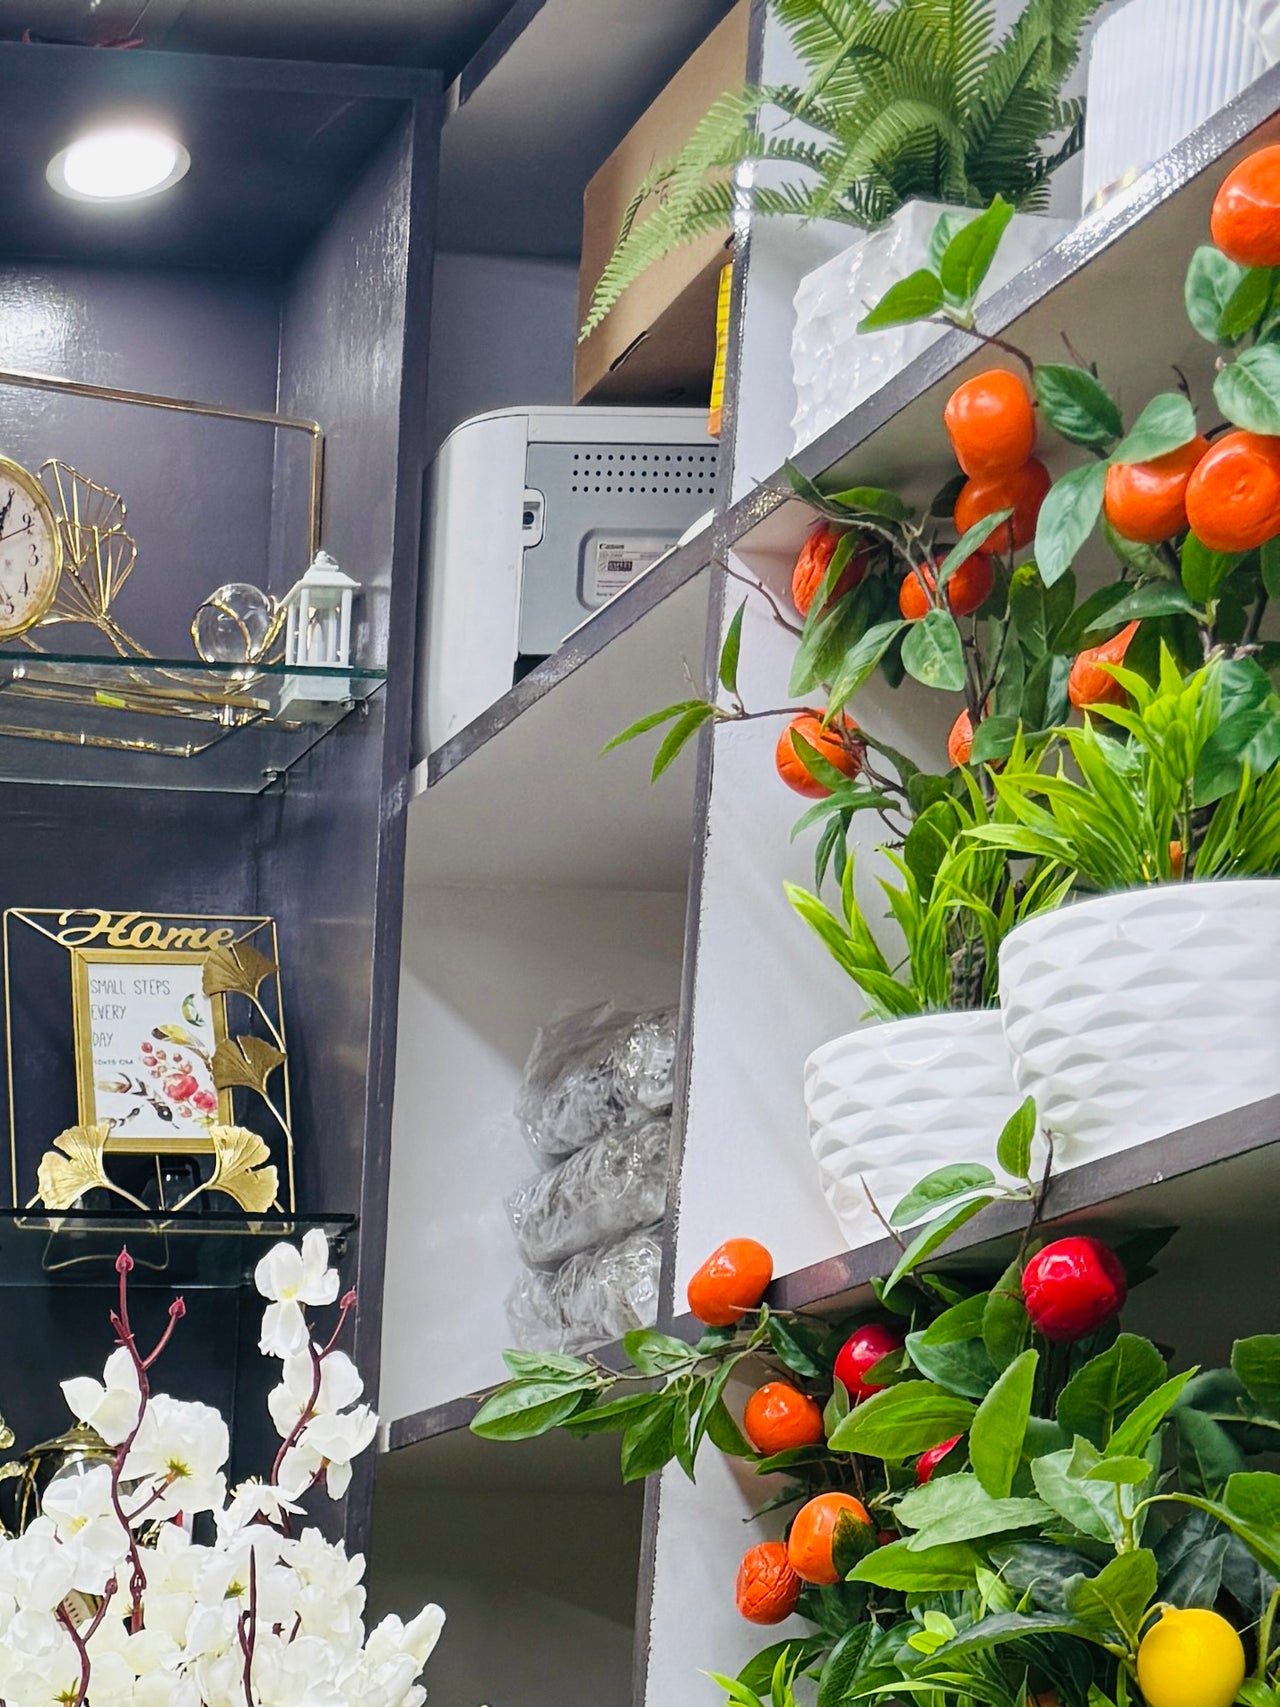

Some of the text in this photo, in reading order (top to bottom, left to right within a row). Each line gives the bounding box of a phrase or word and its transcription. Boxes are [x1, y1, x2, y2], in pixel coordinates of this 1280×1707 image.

[28, 543, 39, 567] 3
[18, 571, 29, 598] 4
[56, 908, 236, 950] Home
[90, 978, 171, 996] SMALL STEPS
[90, 1004, 127, 1021] EVERY
[93, 1031, 114, 1047] DAY
